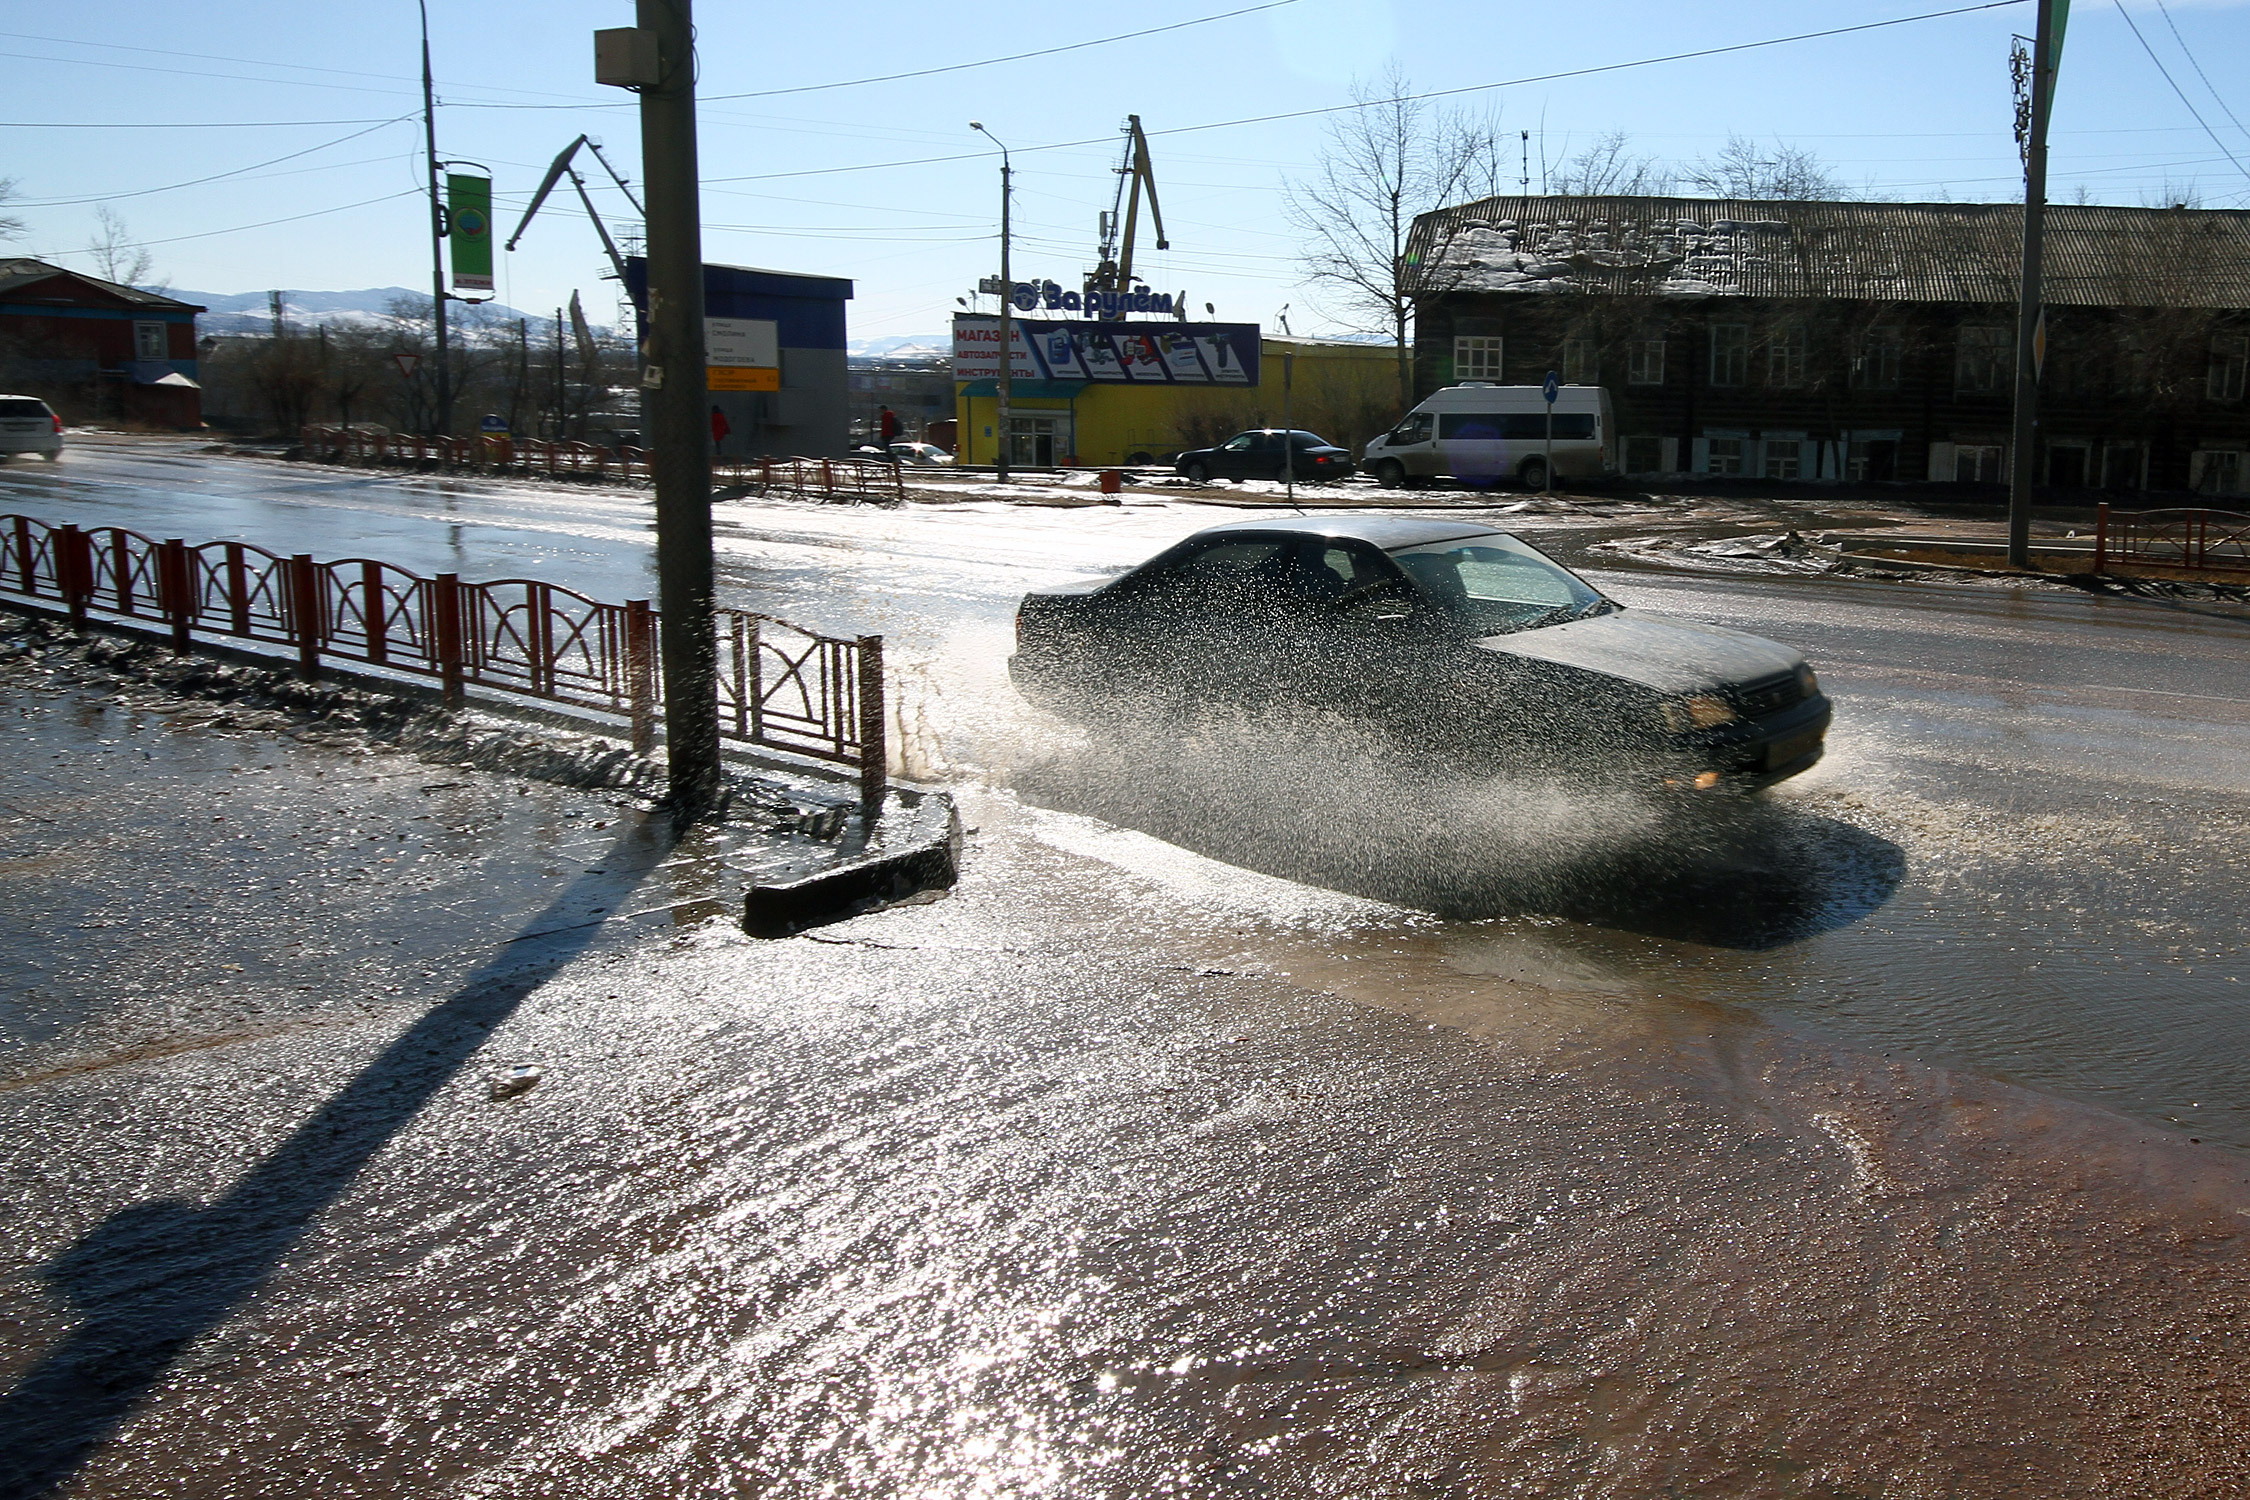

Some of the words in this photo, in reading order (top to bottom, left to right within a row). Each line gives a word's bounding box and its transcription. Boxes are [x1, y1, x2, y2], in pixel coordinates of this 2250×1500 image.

[956, 329, 1020, 342] МАГАЗН
[957, 350, 1027, 360] АВТОЗАПСТИ
[957, 368, 1035, 378] ИНСТРУНТЫ
